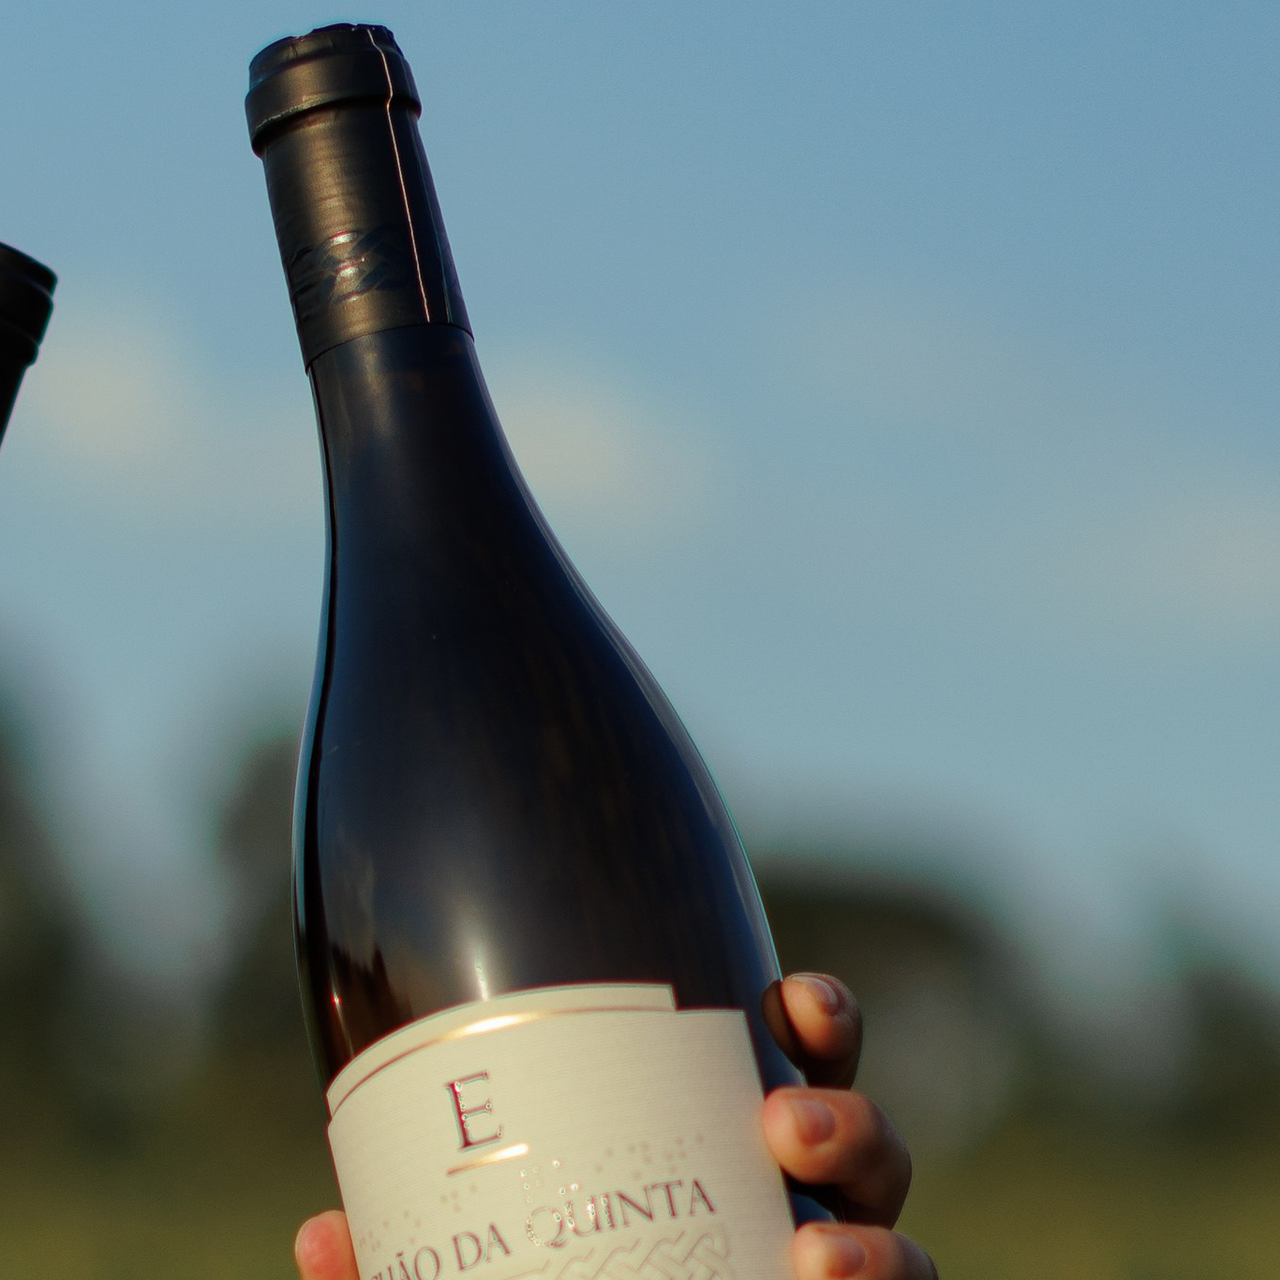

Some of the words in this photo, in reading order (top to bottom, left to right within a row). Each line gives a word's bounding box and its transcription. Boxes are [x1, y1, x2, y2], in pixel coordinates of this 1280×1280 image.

[444, 1070, 504, 1151] E
[452, 1223, 512, 1272] DA
[525, 1179, 715, 1249] QUINTA
